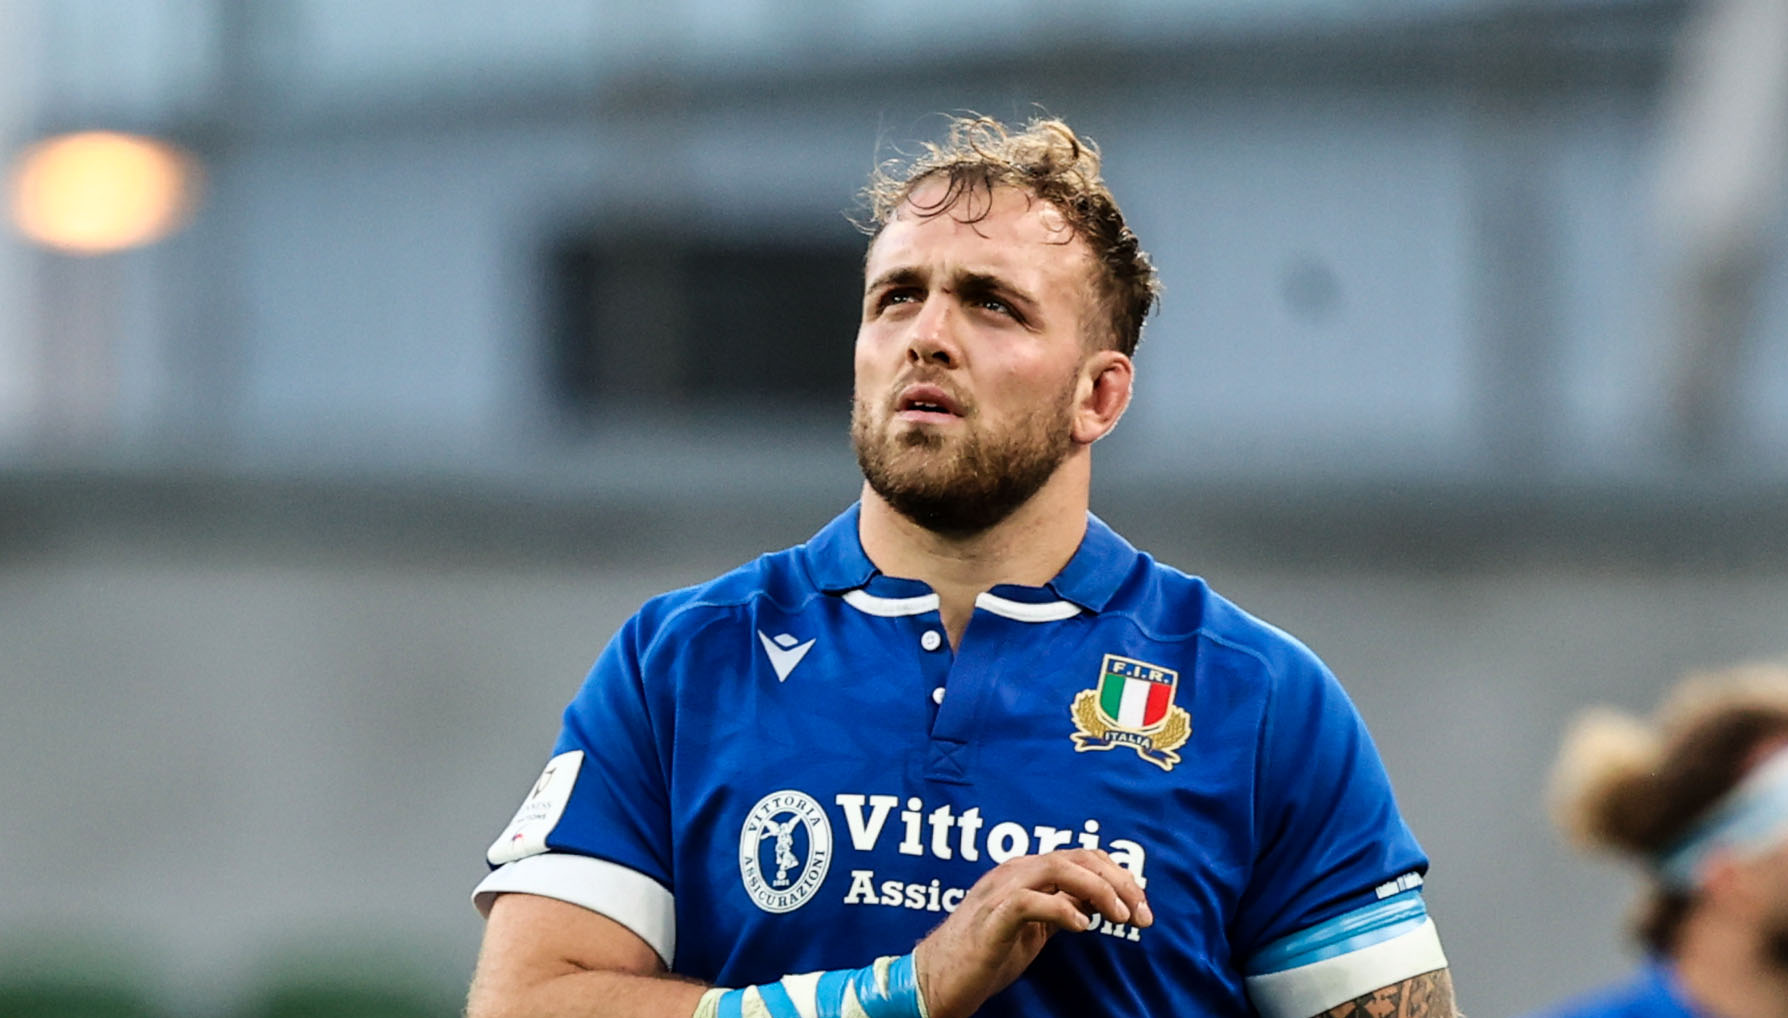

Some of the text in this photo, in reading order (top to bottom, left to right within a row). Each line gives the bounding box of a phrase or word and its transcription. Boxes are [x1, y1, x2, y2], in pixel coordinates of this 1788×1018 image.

[1112, 661, 1169, 684] F.I.R.
[1104, 731, 1151, 749] ITALIA
[747, 795, 822, 833] VITTORIA
[744, 850, 826, 907] ASSICURAZIONI
